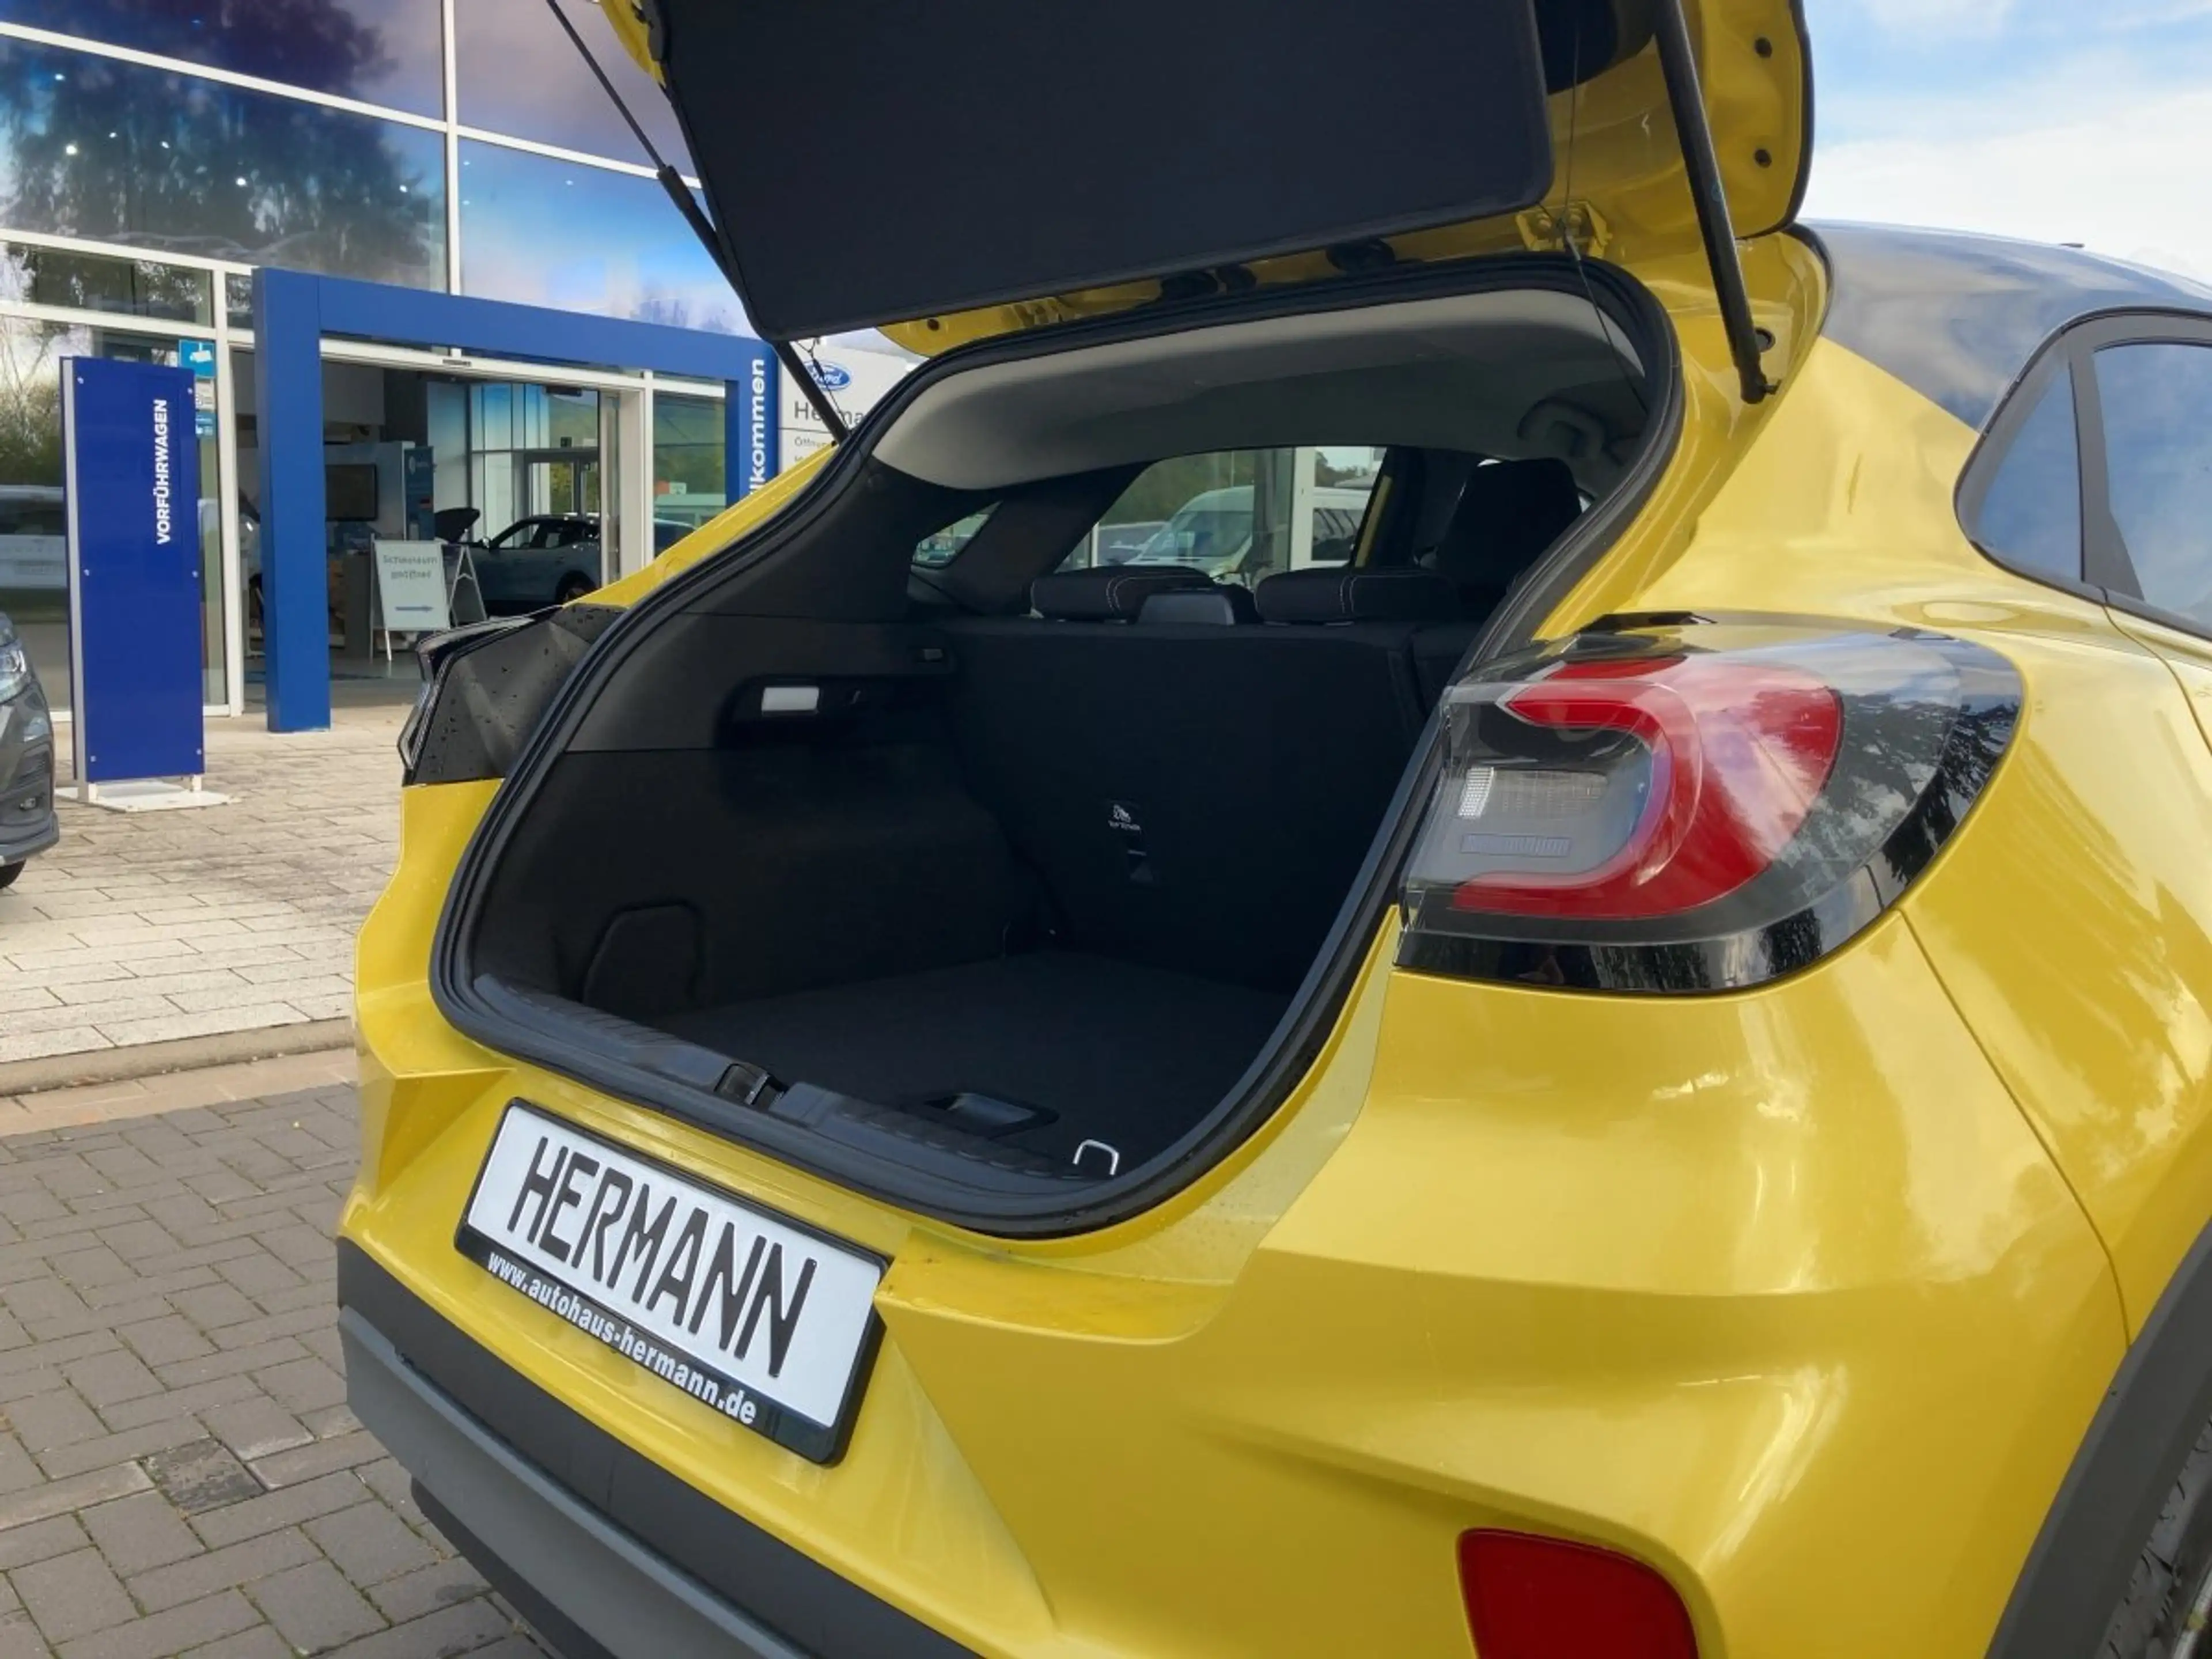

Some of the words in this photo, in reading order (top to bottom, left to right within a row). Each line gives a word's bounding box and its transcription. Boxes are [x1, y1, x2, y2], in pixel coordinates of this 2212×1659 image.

[153, 399, 171, 545] VORFÜHRWAGEN
[750, 358, 766, 495] lkommen
[506, 1137, 817, 1378] HERMANN
[487, 1251, 756, 1425] www.autohaus-hermann.de
